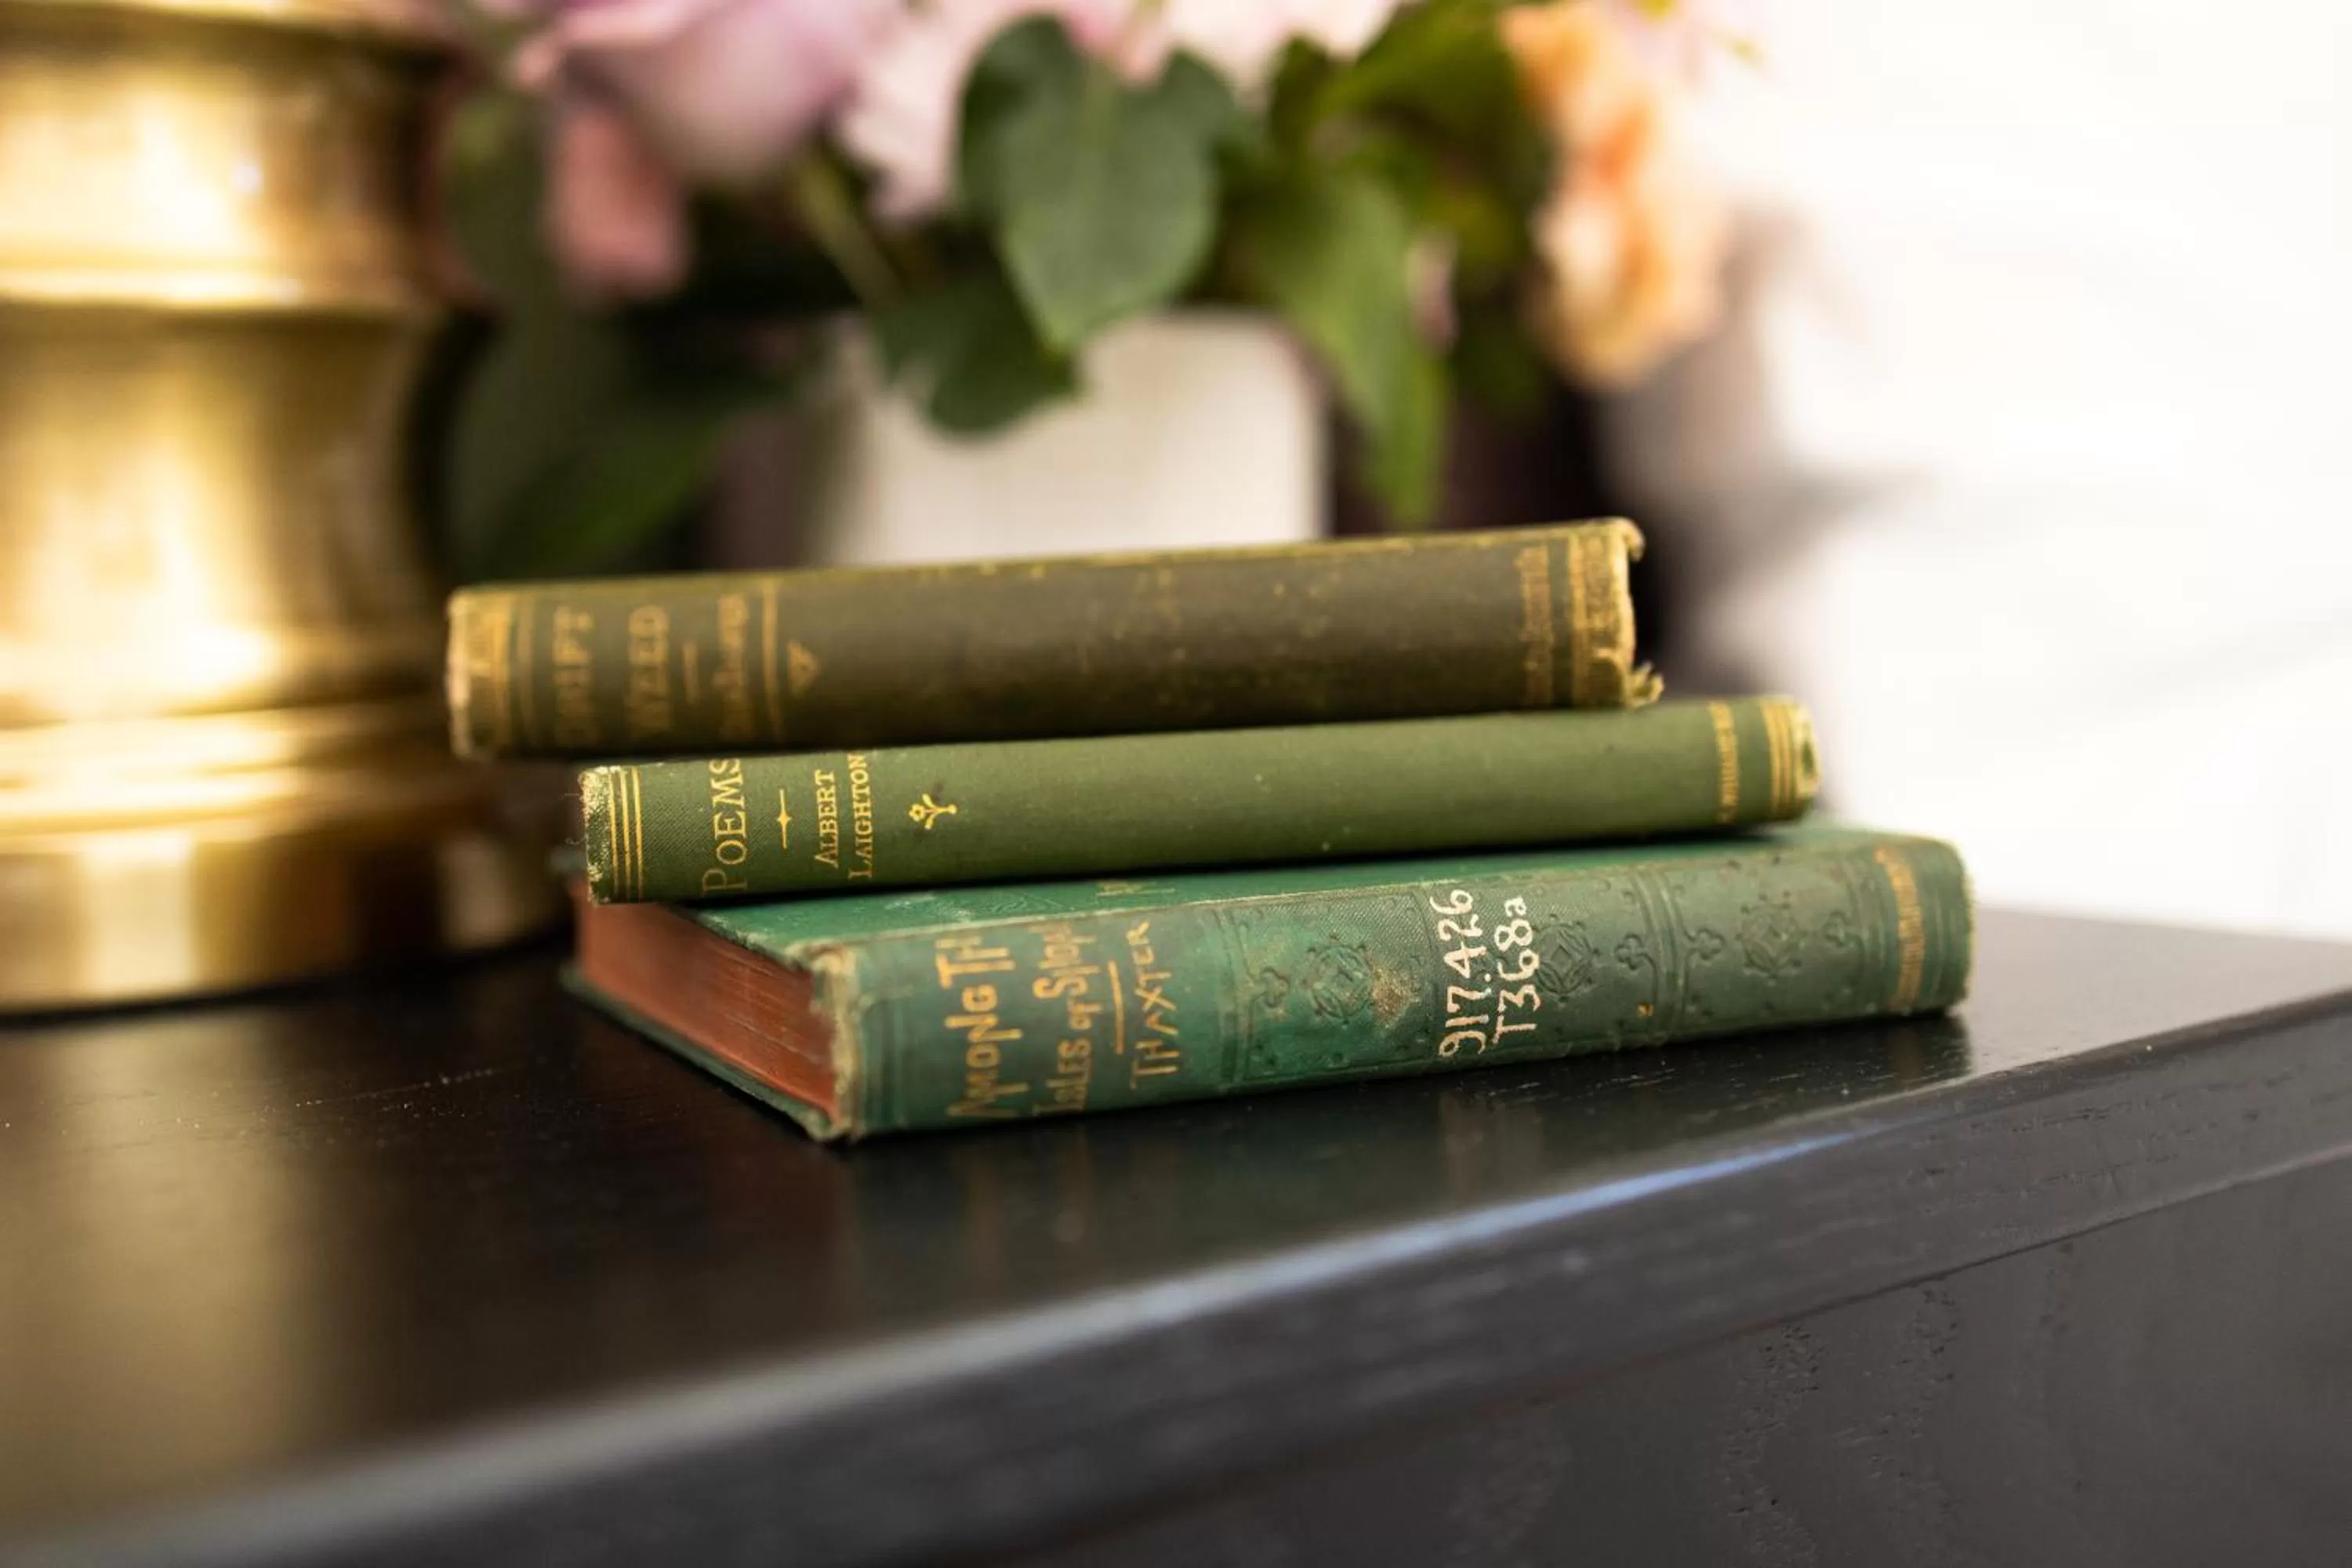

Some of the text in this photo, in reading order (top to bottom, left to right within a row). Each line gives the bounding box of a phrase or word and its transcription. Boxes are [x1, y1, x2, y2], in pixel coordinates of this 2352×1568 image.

[702, 757, 747, 892] POEMS
[814, 768, 839, 869] ALBERT
[848, 753, 873, 879] LAIGHTON
[935, 936, 1029, 1117] AMONG TH
[1126, 920, 1180, 1090] THAXTER
[1429, 889, 1492, 1057] 917.426
[1493, 895, 1541, 1046] T368a
